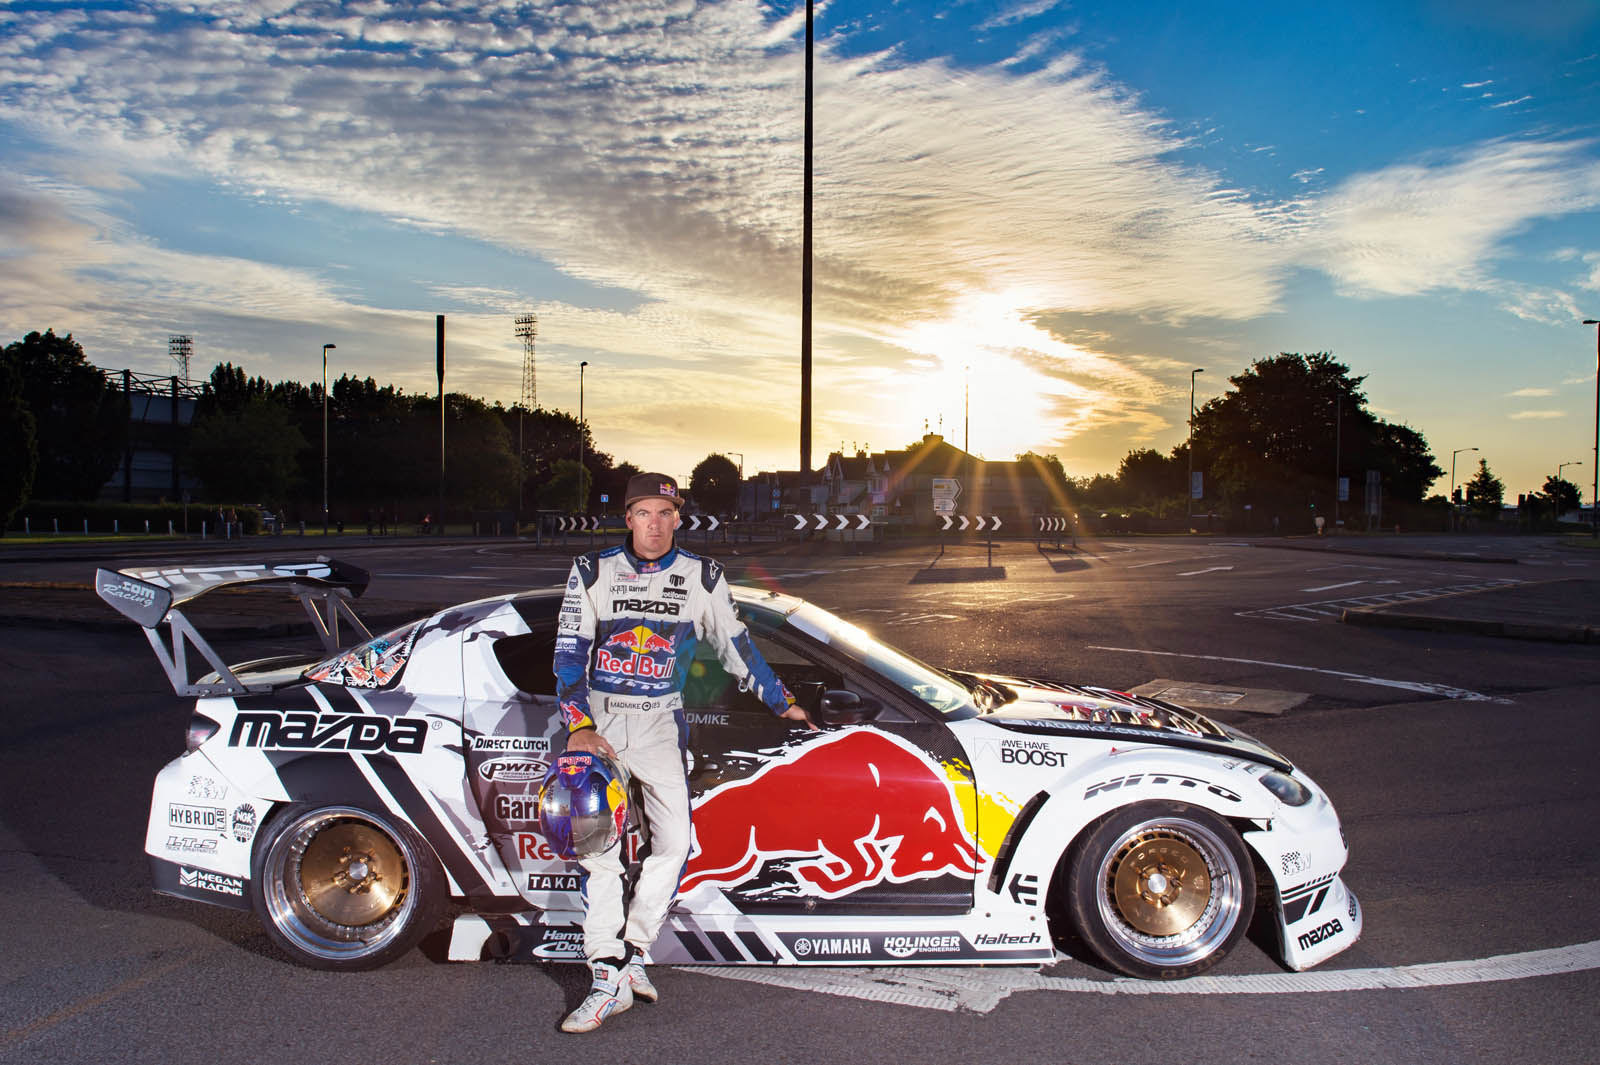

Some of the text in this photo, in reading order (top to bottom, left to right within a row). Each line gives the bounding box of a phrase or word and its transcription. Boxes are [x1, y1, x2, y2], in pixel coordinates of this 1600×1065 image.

[103, 584, 153, 607] Racing
[596, 649, 676, 678] Red Bull
[685, 713, 730, 725] DMIKE
[475, 737, 549, 751] DIRECT CLUTCH
[1023, 741, 1050, 750] HAVE
[1001, 748, 1068, 767] BOOST
[487, 763, 543, 780] PWR
[171, 808, 225, 830] HYBRID LAB
[236, 810, 255, 824] NGK
[519, 834, 570, 860] Re
[198, 871, 242, 888] MEGAN
[531, 876, 578, 889] TAKA
[198, 881, 242, 896] RACING
[543, 930, 585, 943] Hamp
[812, 932, 1041, 954] YAMAHA HOLINGER Haltech
